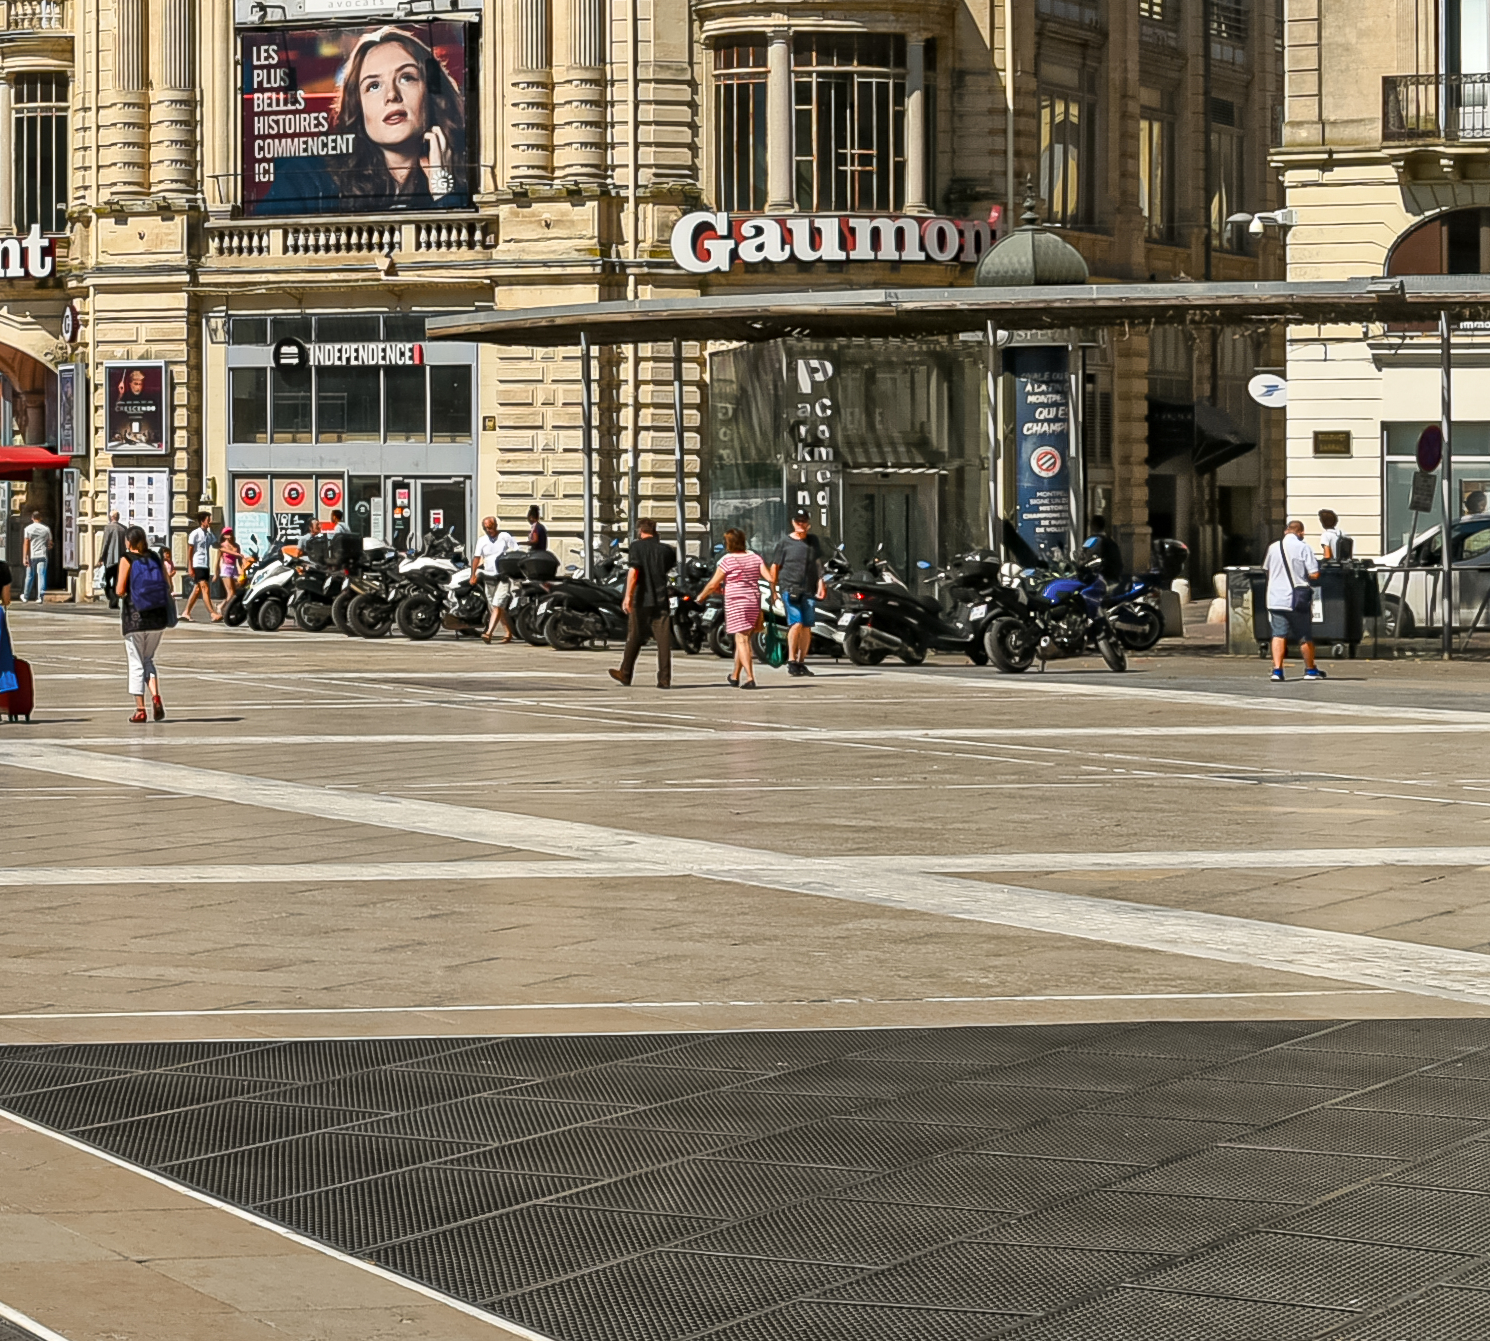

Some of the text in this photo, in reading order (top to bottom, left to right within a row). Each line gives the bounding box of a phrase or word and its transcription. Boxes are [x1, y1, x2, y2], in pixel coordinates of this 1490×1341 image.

[252, 45, 279, 66] LES
[253, 67, 290, 89] PLUS
[253, 90, 306, 113] BELLES
[254, 112, 329, 136] HISTOIRES
[254, 134, 356, 159] COMMENCENT
[254, 162, 275, 183] ICI
[308, 343, 414, 366] INDEPENDENCE
